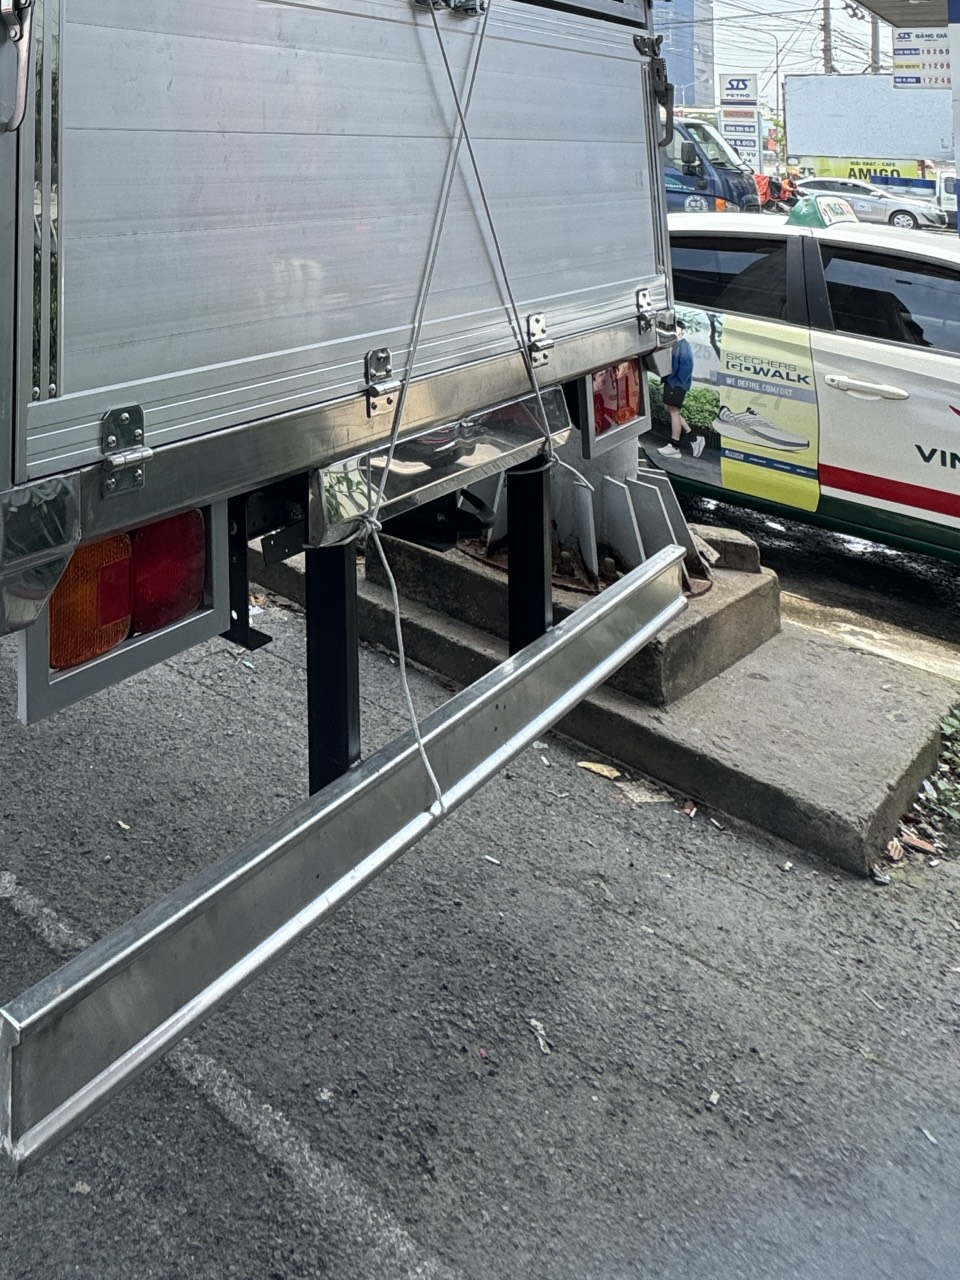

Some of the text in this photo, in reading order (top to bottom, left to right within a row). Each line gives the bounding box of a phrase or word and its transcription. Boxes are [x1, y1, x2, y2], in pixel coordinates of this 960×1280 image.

[848, 167, 901, 180] AMIGO
[725, 352, 798, 372] SKECHERS
[725, 377, 793, 397] WE DEFINE COMFORT
